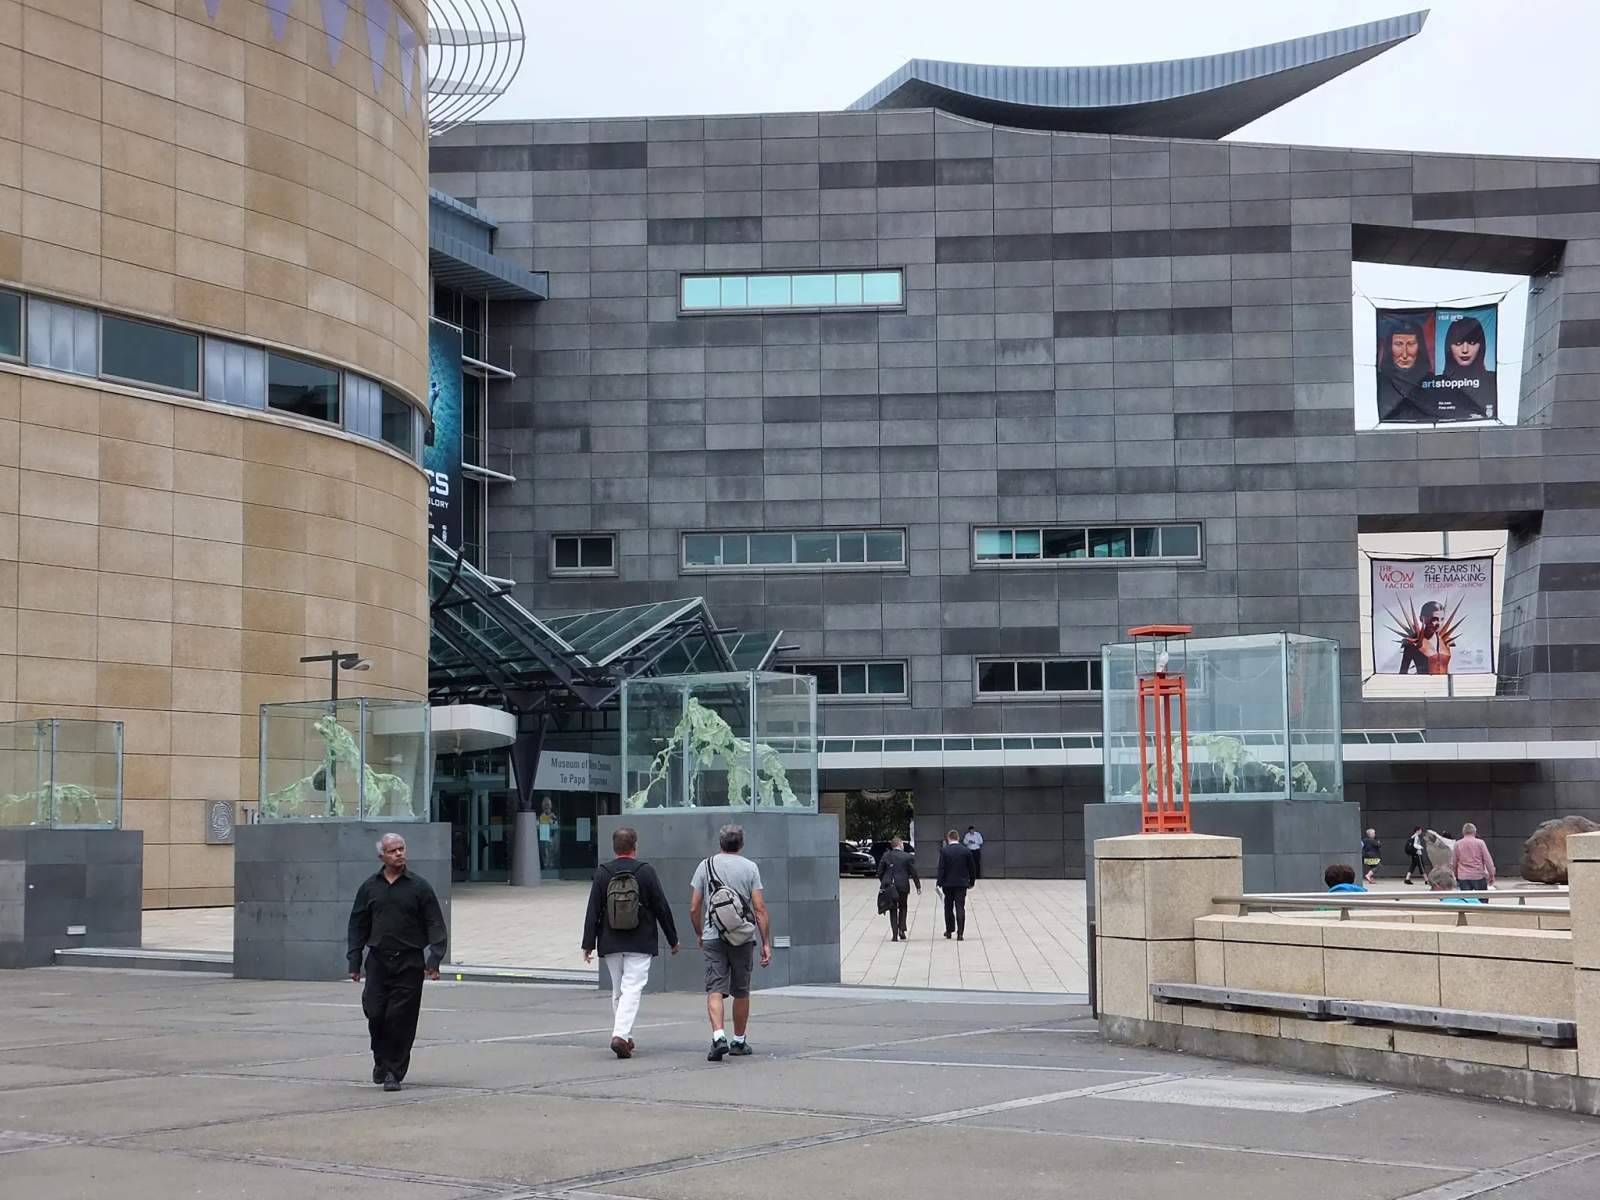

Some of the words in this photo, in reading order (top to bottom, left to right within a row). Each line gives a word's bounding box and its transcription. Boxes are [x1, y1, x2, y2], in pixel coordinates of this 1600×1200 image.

[1422, 378, 1480, 389] artstopping
[1424, 565, 1436, 574] 25
[1438, 564, 1467, 573] YEARS
[1470, 564, 1481, 572] IN
[1379, 570, 1415, 583] WOW
[1424, 574, 1441, 582] THE
[1443, 573, 1486, 582] MAKING
[551, 758, 580, 769] Museum
[582, 759, 588, 769] of
[560, 773, 568, 784] Te
[569, 774, 586, 786] Papa
